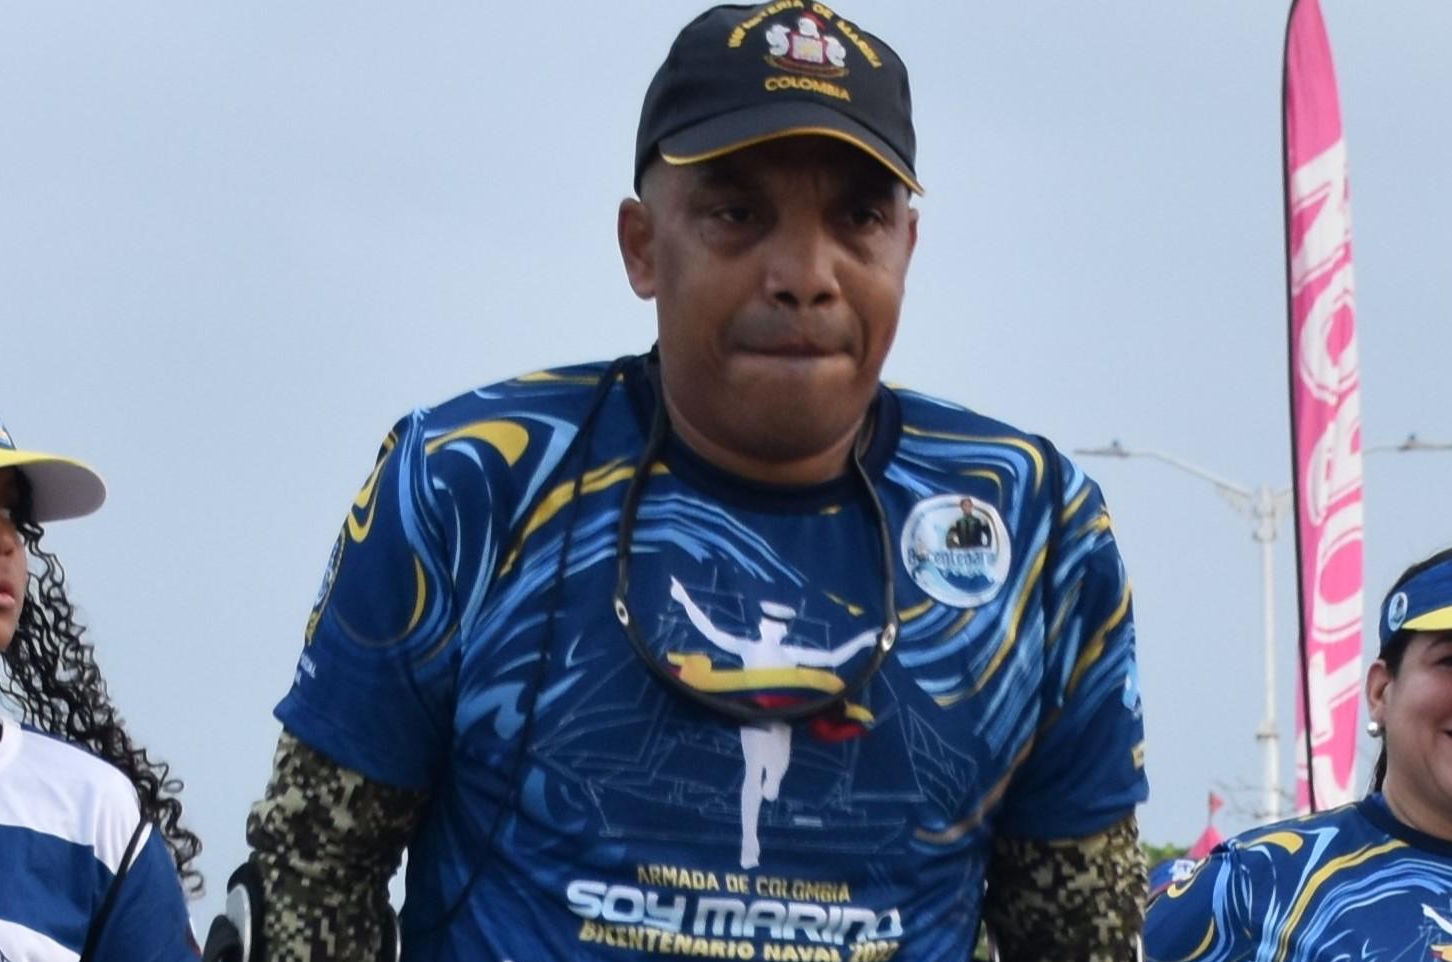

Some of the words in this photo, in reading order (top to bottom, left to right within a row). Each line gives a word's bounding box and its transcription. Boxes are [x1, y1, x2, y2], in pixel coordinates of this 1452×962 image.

[764, 76, 851, 102] COLOMBIA
[637, 864, 720, 892] ARMADA
[725, 872, 750, 894] DE
[756, 875, 852, 904] COLOMBIA
[566, 879, 687, 933] SOY
[578, 919, 755, 960] BICENTENARIO
